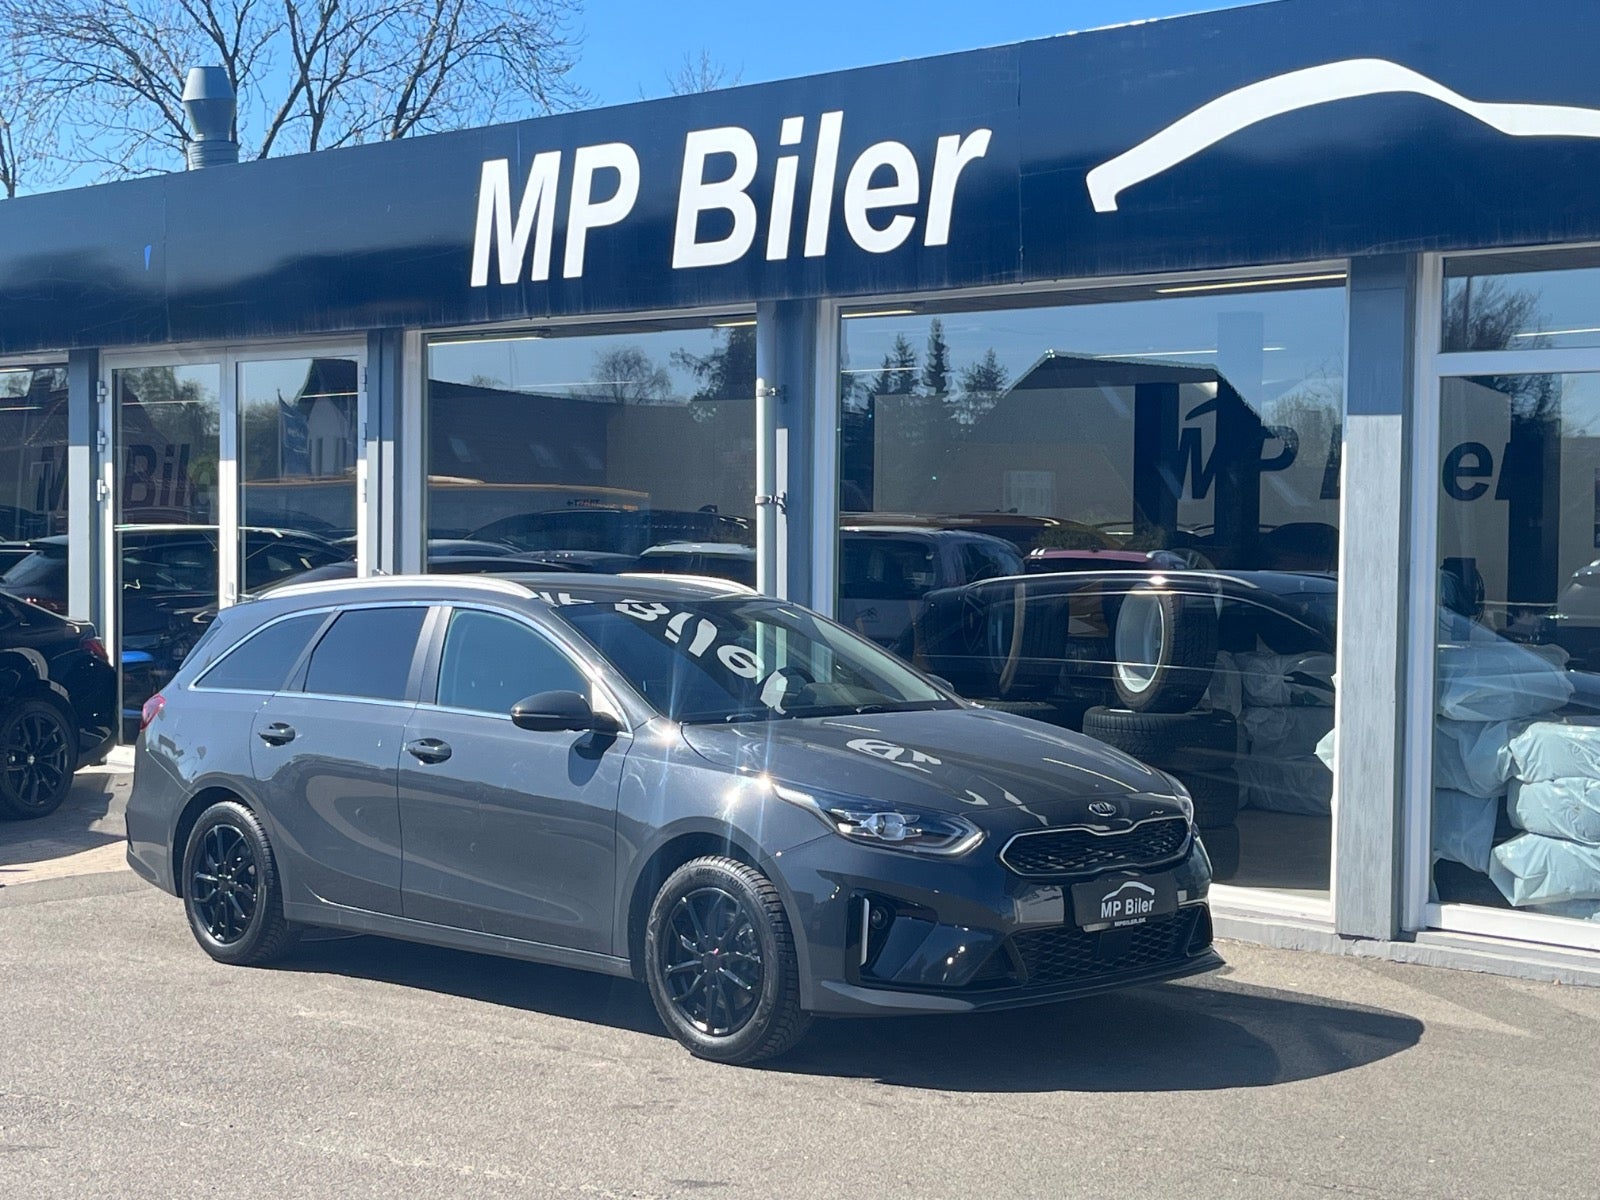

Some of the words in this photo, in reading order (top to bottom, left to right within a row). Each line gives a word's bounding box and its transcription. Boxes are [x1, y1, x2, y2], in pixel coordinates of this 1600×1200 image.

[470, 142, 640, 287] MP
[672, 110, 992, 269] Biler
[1101, 901, 1121, 918] MP
[1125, 897, 1154, 915] Biler
